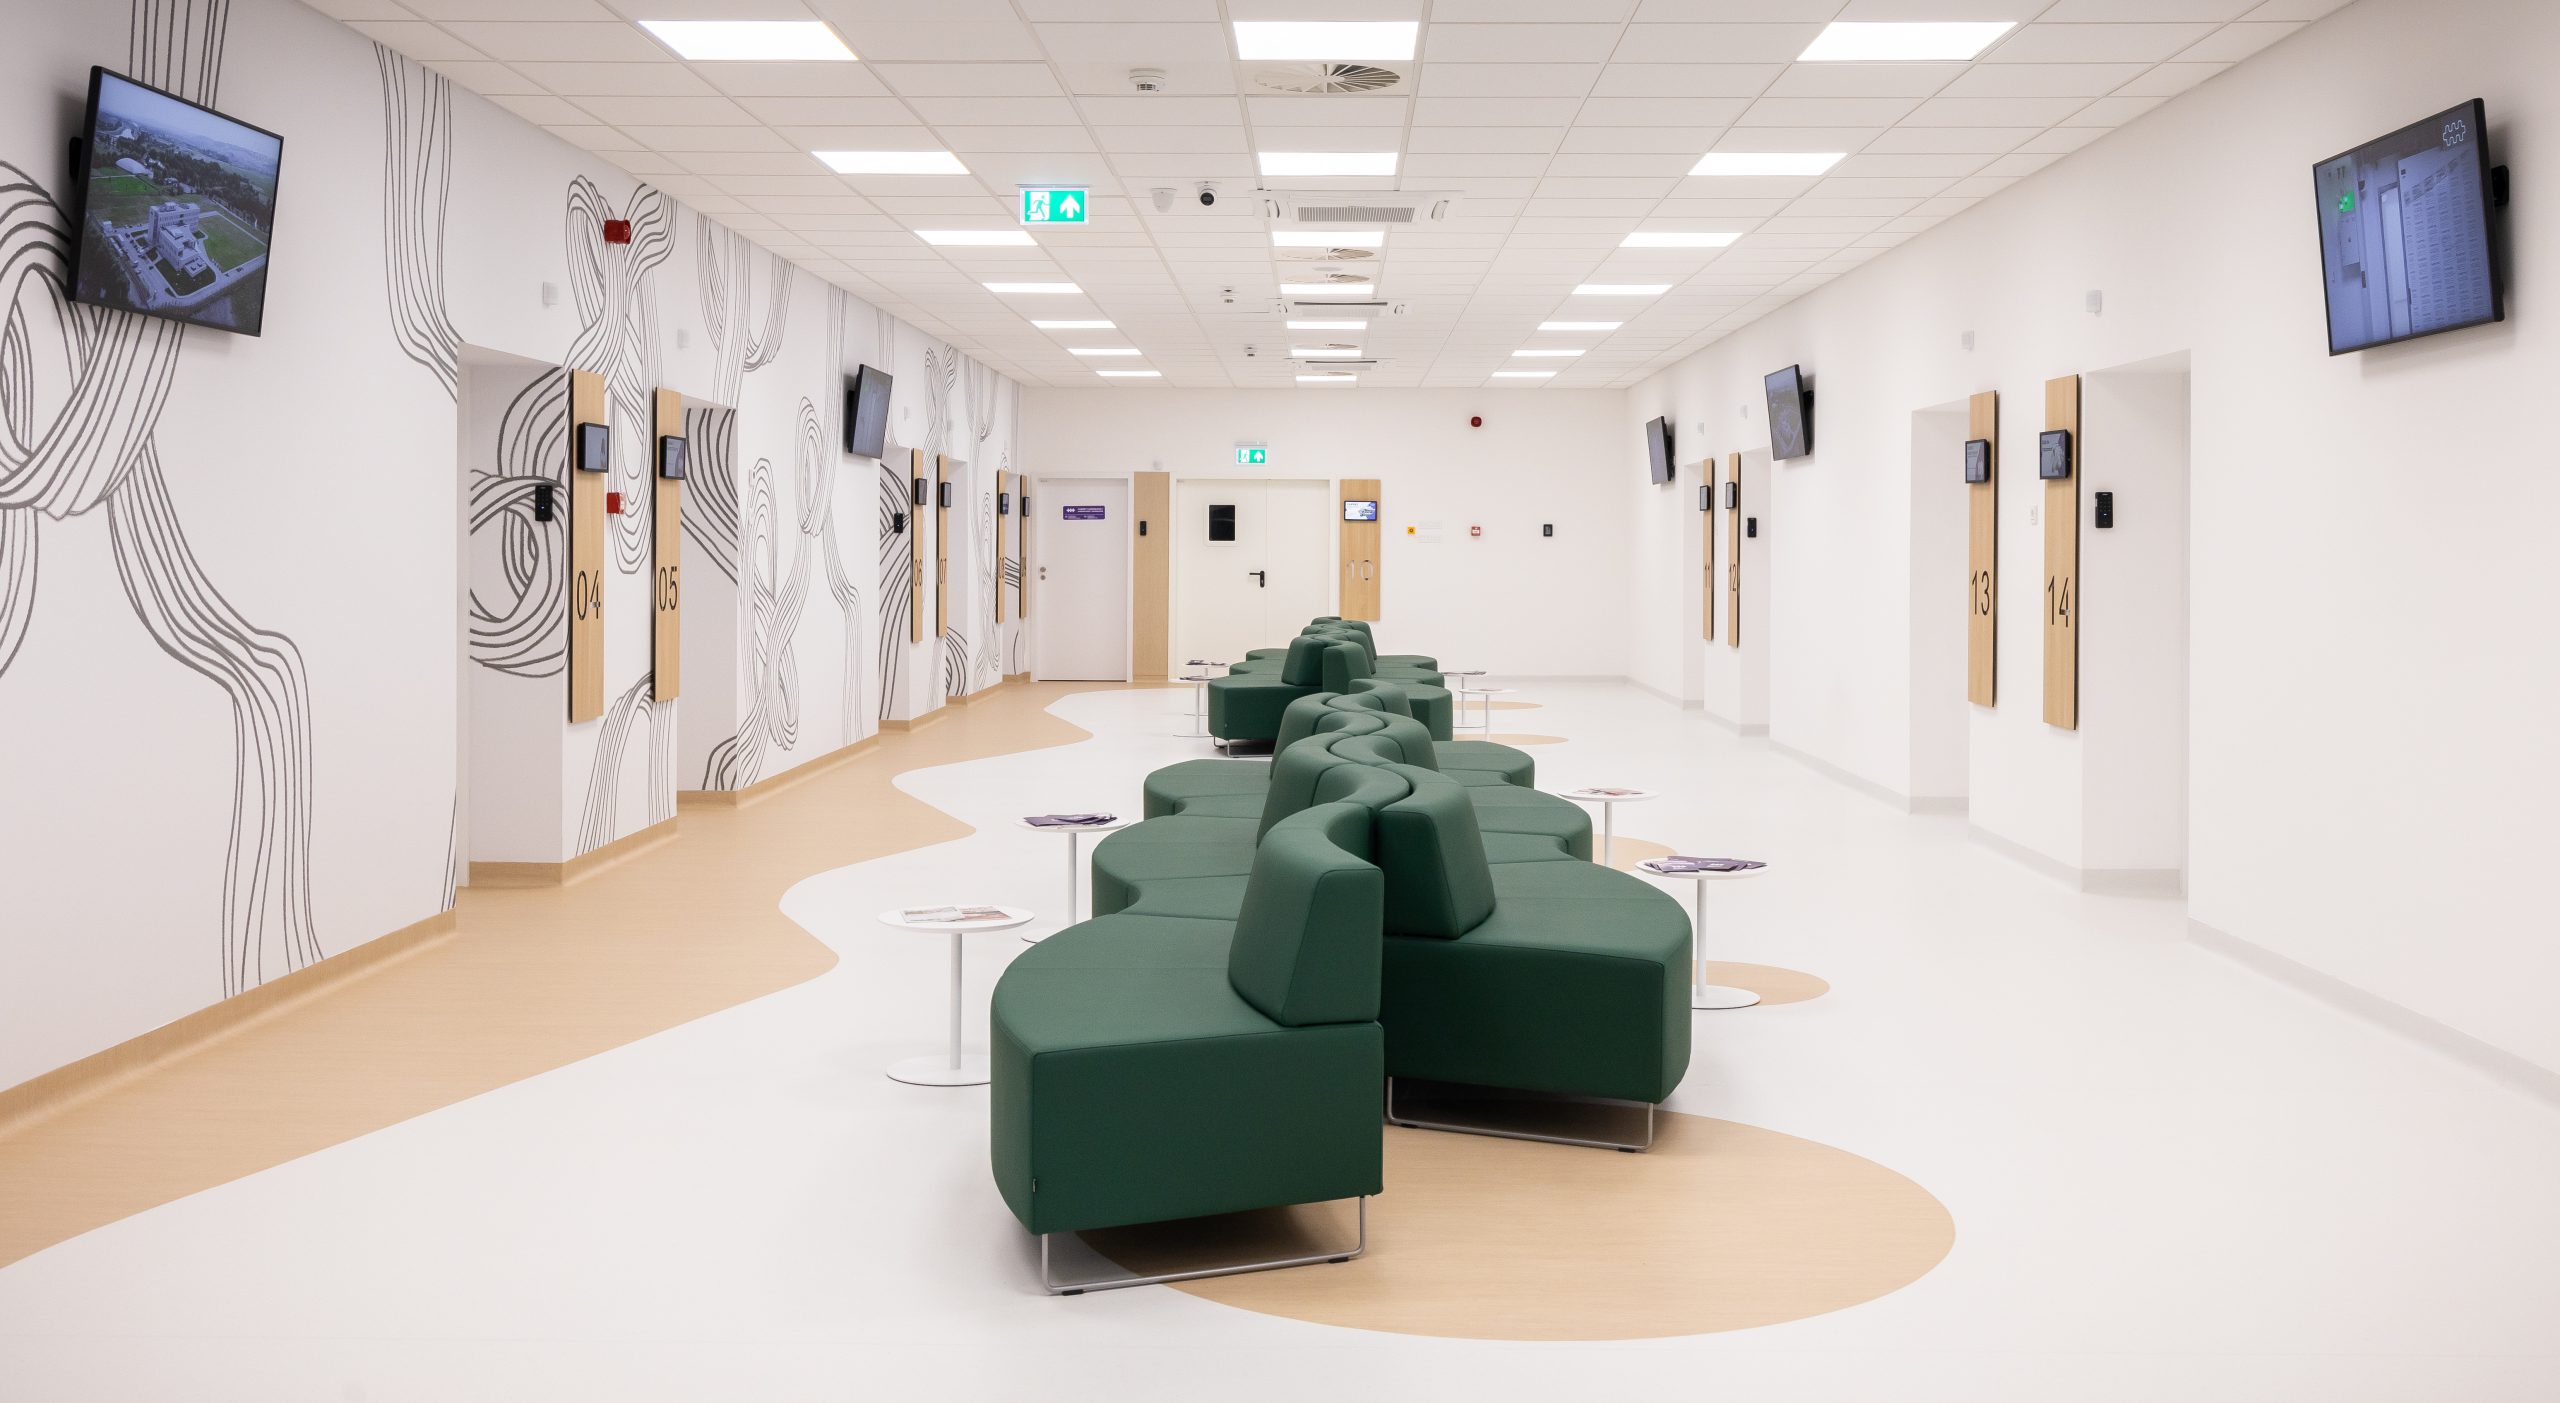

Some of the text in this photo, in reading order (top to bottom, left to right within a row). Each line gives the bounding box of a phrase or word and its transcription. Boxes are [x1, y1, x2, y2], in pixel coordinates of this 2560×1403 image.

[659, 566, 678, 611] 05
[914, 559, 923, 587] 06
[1347, 560, 1374, 581] 10
[1729, 563, 1736, 591] 12
[1972, 570, 1990, 616] 13
[577, 569, 600, 620] 04
[2048, 575, 2070, 628] 14
